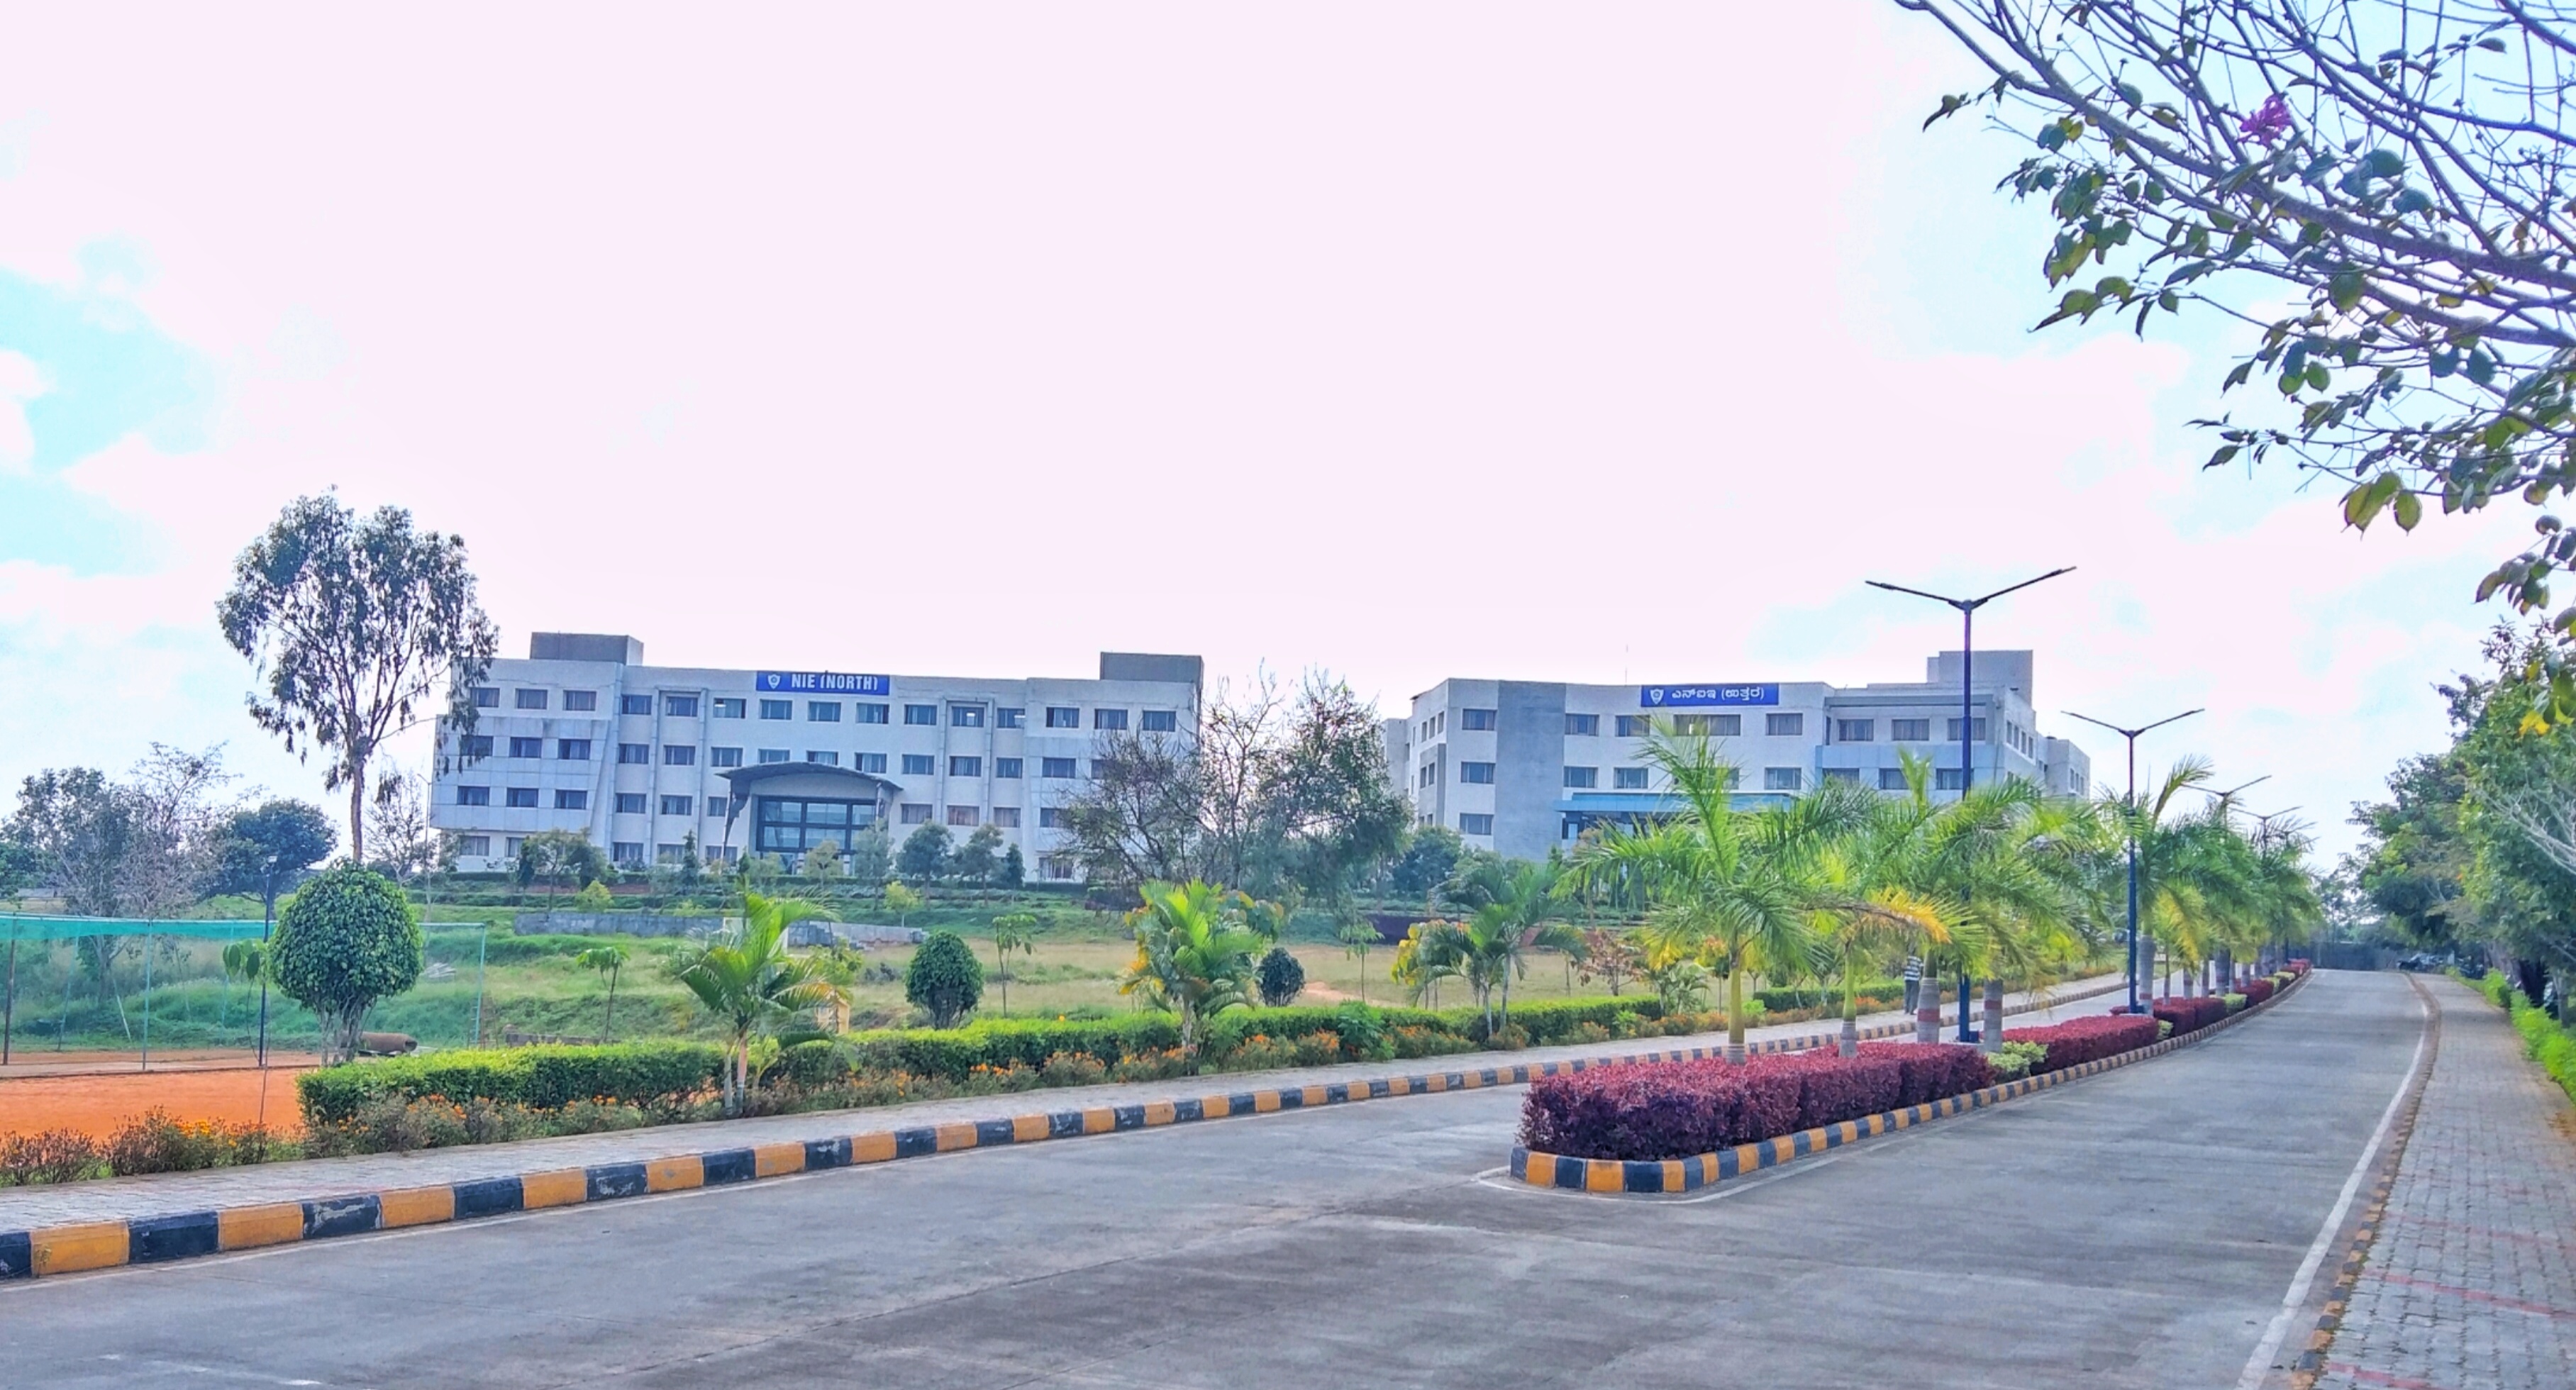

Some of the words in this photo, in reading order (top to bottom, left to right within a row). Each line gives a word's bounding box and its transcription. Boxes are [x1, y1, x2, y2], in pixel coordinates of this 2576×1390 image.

[792, 673, 816, 689] NIE
[820, 674, 878, 691] (NORTH)
[1721, 686, 1765, 701] (ಉತ್ತರ)
